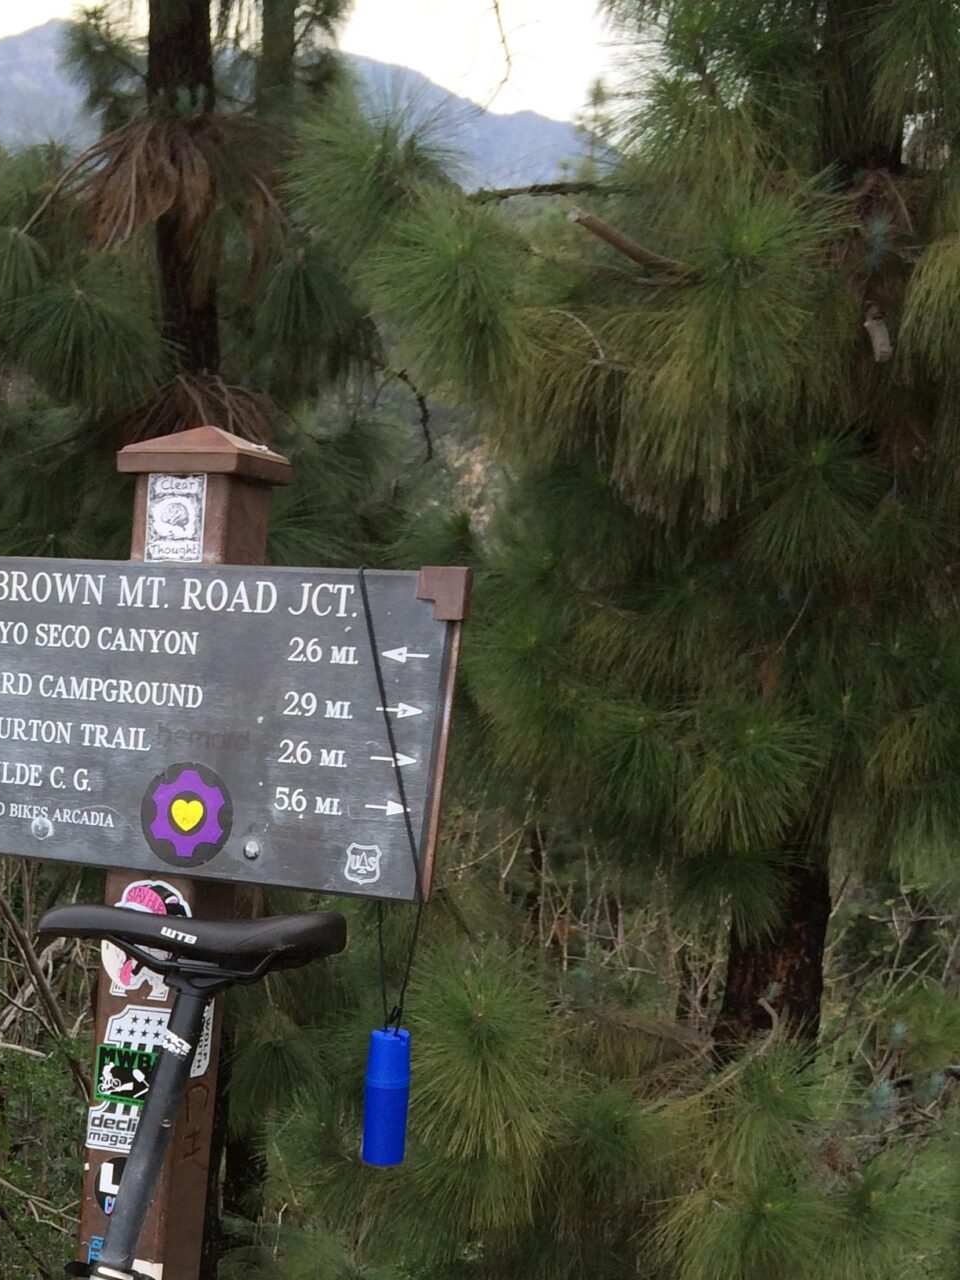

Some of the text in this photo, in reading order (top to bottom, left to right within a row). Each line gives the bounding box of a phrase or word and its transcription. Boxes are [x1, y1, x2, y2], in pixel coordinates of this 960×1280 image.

[160, 479, 196, 490] Clear
[150, 543, 197, 557] Thought
[117, 575, 169, 609] MT.
[181, 578, 278, 614] ROAD
[288, 582, 358, 618] JCT.
[35, 623, 90, 650] SECO
[97, 626, 200, 656] CANYON
[39, 674, 204, 709] CAMPGROUND
[81, 723, 151, 751] TRAIL
[9, 803, 49, 820] BIKES
[52, 808, 115, 828] ARCADIA
[160, 926, 198, 945] WTB
[100, 1047, 156, 1070] MWB
[91, 1114, 138, 1132] decli
[88, 1131, 134, 1146] magaz
